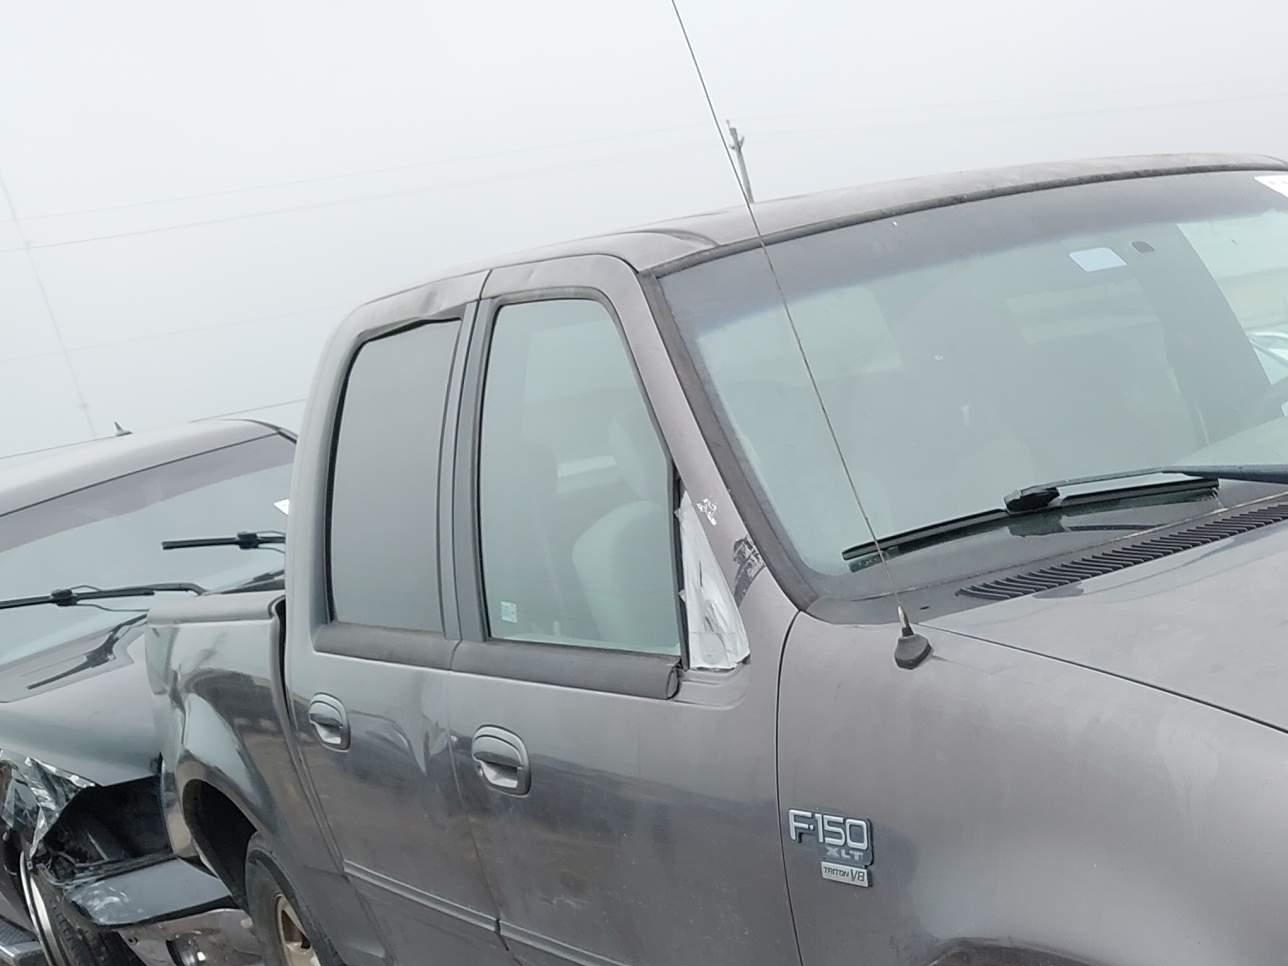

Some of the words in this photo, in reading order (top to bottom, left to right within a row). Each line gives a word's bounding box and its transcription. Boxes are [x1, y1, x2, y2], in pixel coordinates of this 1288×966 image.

[825, 846, 865, 861] XLT
[823, 866, 850, 878] TRITON
[850, 868, 866, 882] V8
